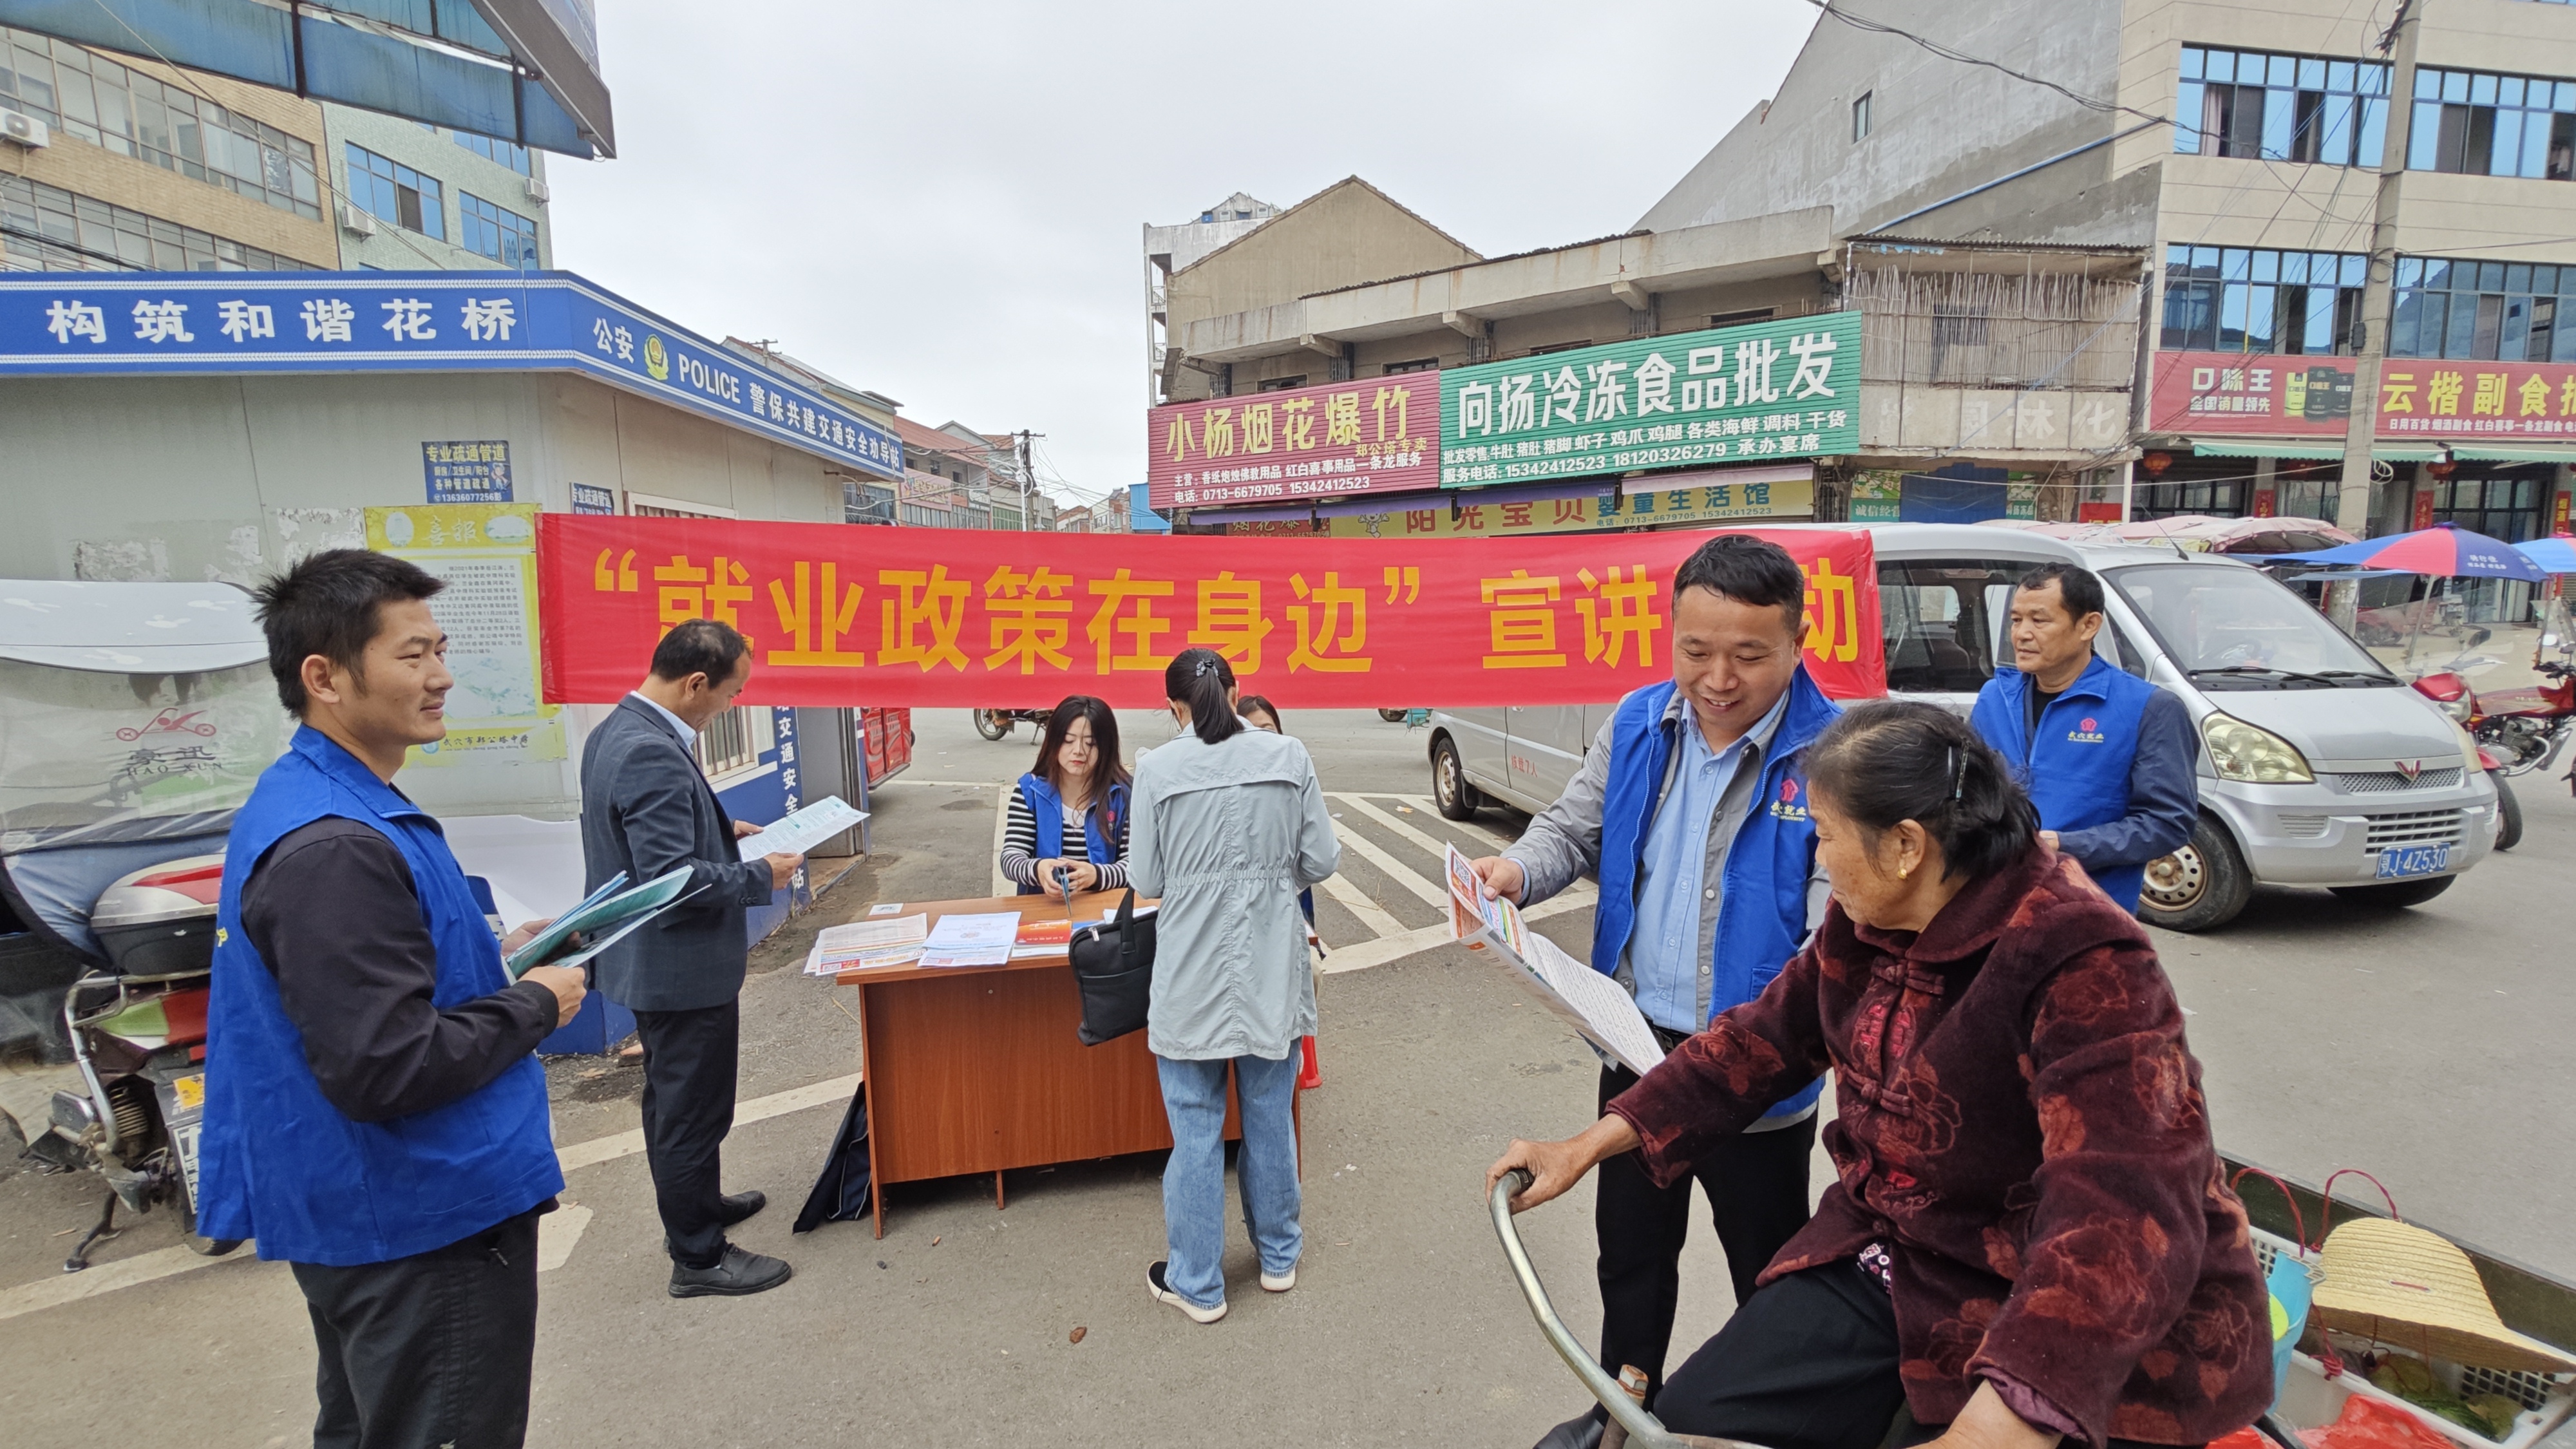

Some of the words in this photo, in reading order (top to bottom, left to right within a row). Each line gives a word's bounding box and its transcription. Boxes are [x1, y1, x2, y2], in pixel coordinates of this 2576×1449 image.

[46, 298, 517, 344] 构筑和谐花桥
[592, 317, 635, 364] 公安
[677, 352, 741, 404] POLICE
[1458, 332, 1837, 439] 向扬冷冻食品批发
[749, 382, 900, 469] 警保共建交通安全劝导站
[1166, 385, 1411, 462] 小杨烟花爆竹
[1517, 440, 1541, 457] 猪肚
[1543, 437, 1572, 455] 猪脚
[1575, 432, 1607, 451] 虾子
[1610, 428, 1644, 447] 鸡爪
[1647, 424, 1683, 443] 鸡腿
[1686, 417, 1759, 440] 各类海鲜
[1763, 413, 1801, 432] 调料
[1806, 410, 1847, 430] 干货
[426, 443, 506, 462] 专业疏通管道
[1285, 451, 1423, 478] 红白喜事用品一条龙服务
[1613, 442, 1727, 468] 18120326279
[1738, 433, 1820, 456] 承办宴席
[1289, 477, 1370, 494] 15342412523
[422, 515, 480, 546] 喜报
[1624, 512, 1696, 525] 0713-6679705
[1702, 507, 1772, 518] 15342412523
[1481, 558, 1859, 670] 宣讲动
